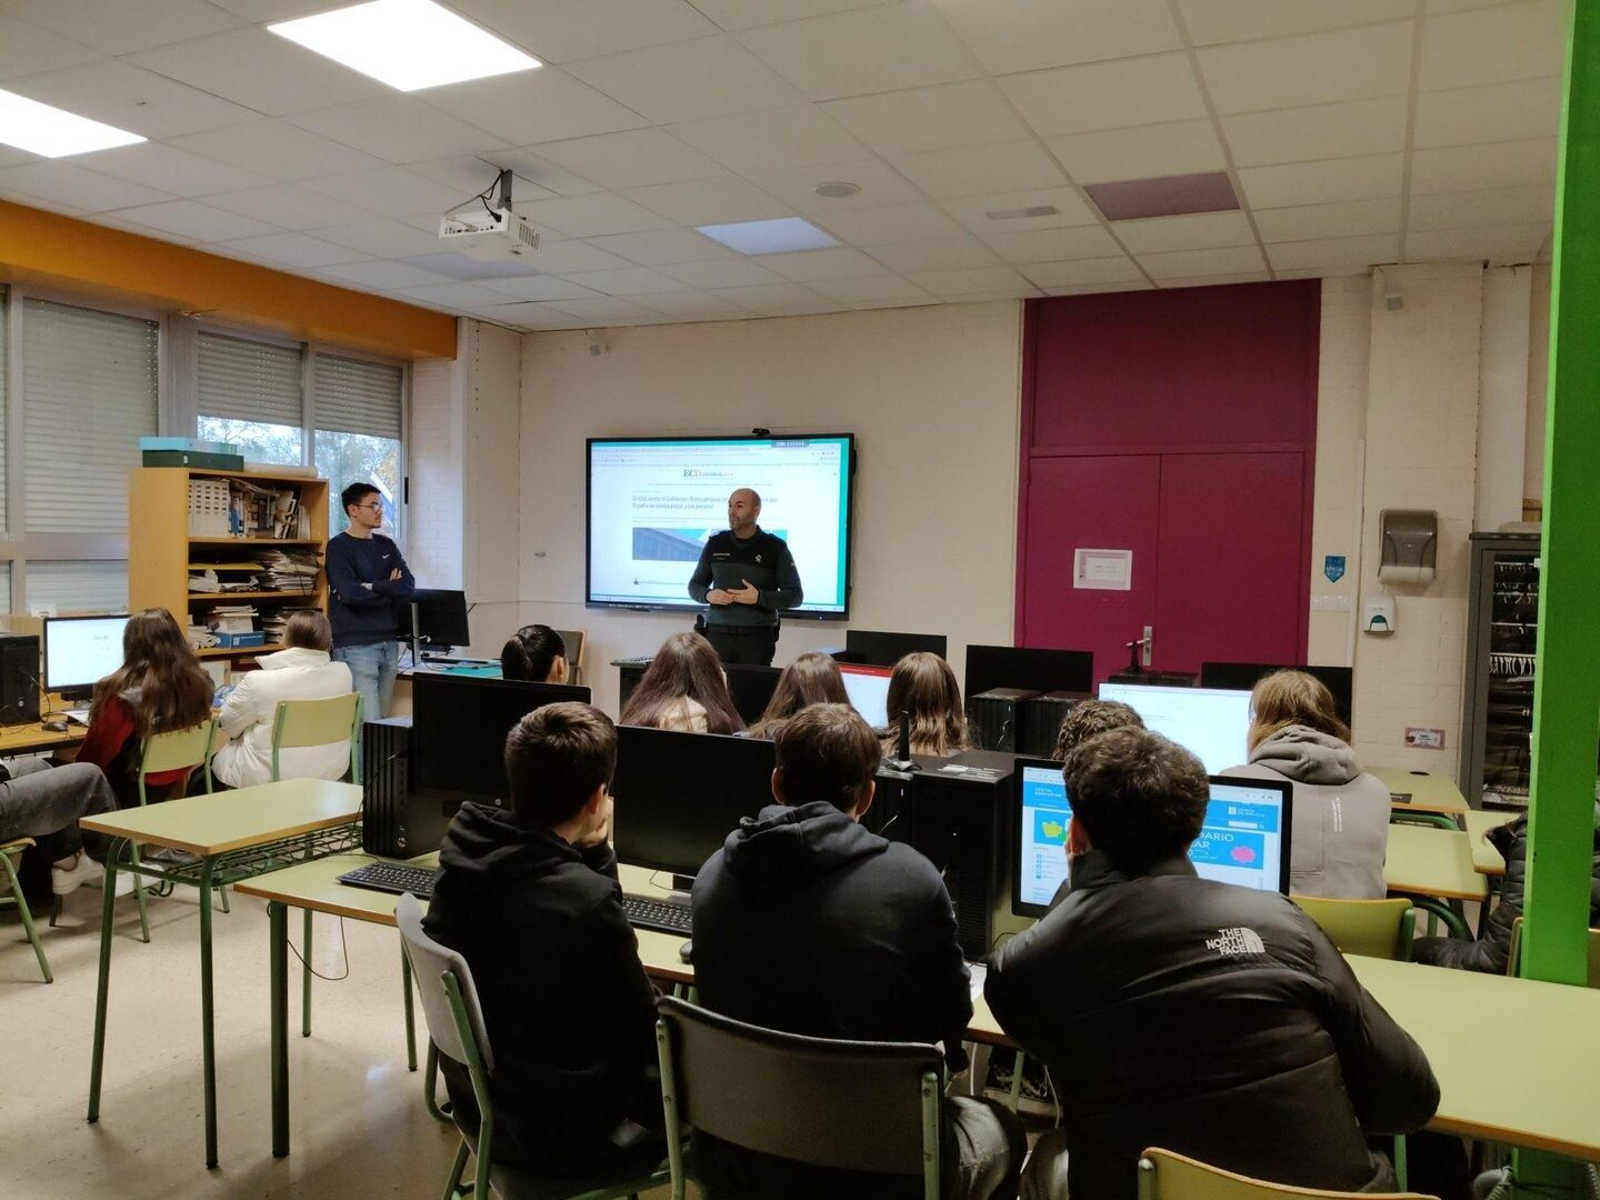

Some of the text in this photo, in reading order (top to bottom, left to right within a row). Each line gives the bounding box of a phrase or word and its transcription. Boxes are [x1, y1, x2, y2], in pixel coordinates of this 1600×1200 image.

[1218, 928, 1242, 939] THE
[1205, 936, 1244, 950] NORTH
[1220, 946, 1247, 956] FACE
